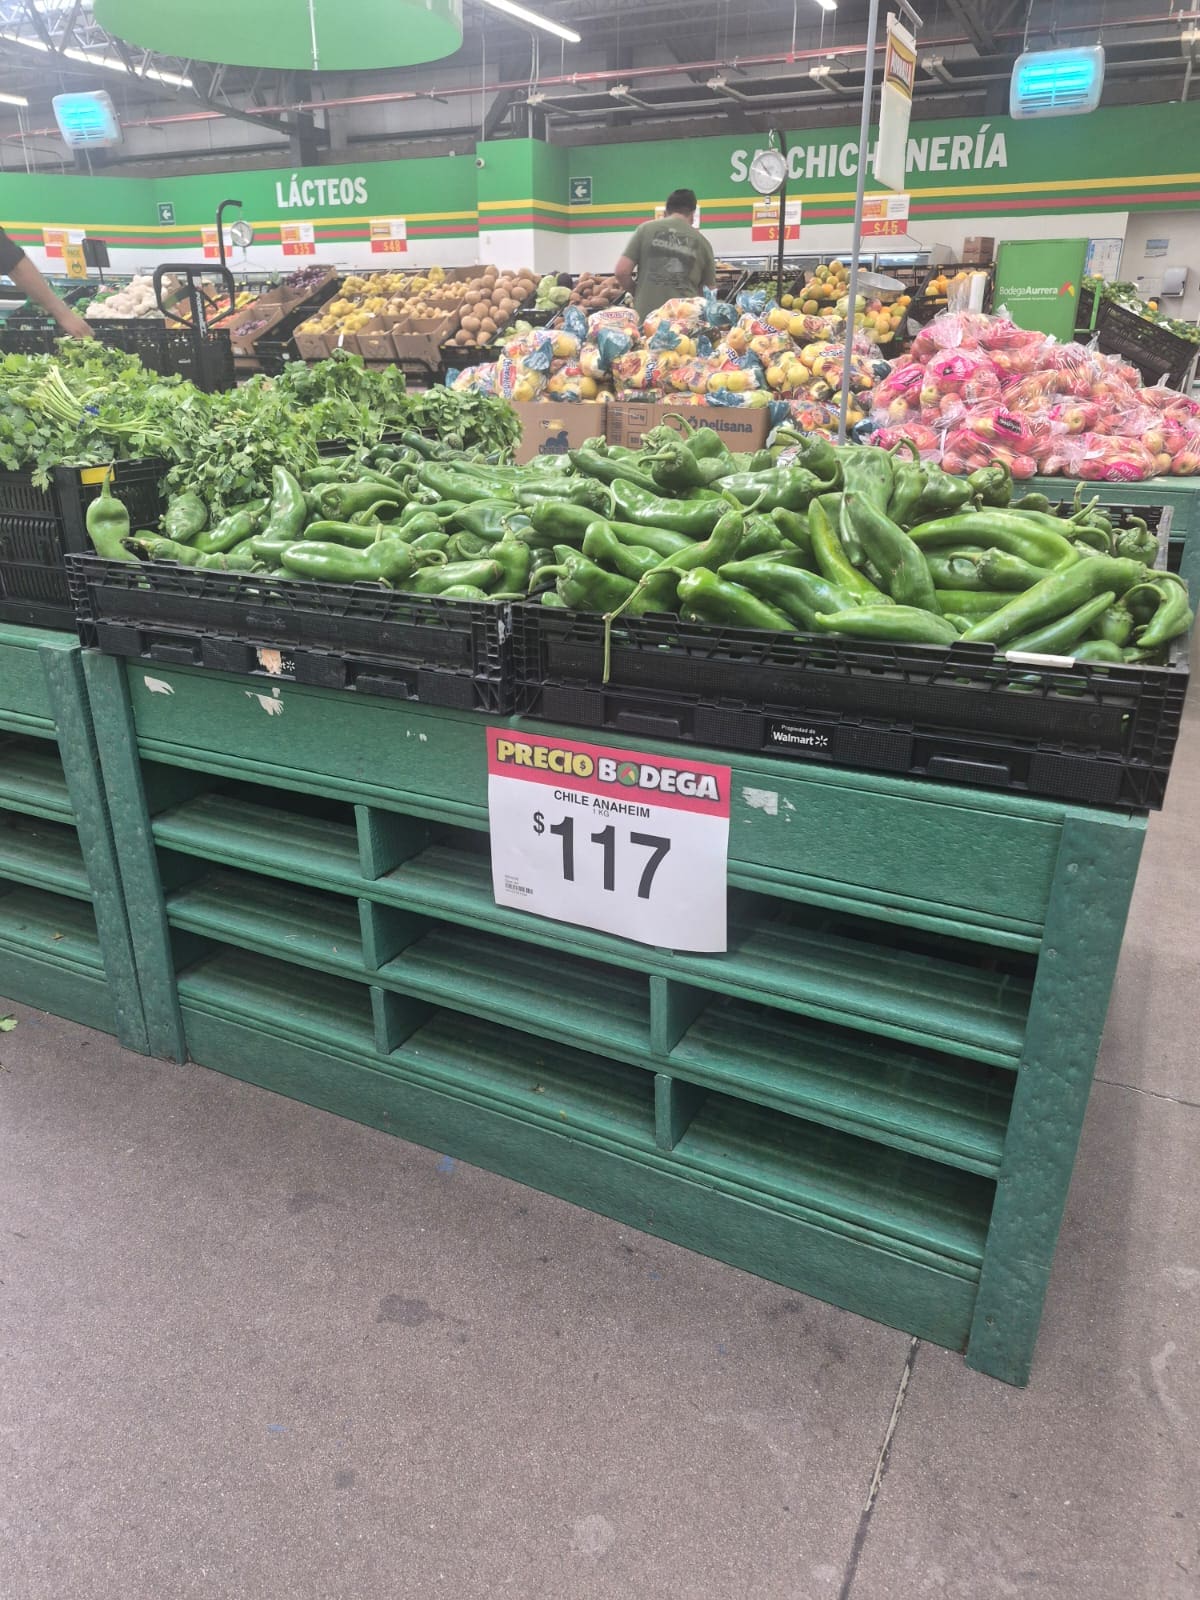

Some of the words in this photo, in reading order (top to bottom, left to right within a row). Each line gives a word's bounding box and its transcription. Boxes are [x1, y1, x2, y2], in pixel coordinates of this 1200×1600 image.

[730, 124, 1008, 182] SCHICHNERÍA
[275, 173, 368, 208] LÁCTEOS
[768, 225, 791, 240] $7
[699, 418, 753, 433] Delisana
[773, 731, 814, 745] Walmart
[496, 738, 593, 778] PRECIO
[598, 757, 721, 802] BODEGA
[554, 790, 589, 807] CHILE
[593, 798, 650, 818] ANAHEIM
[598, 809, 609, 817] KG
